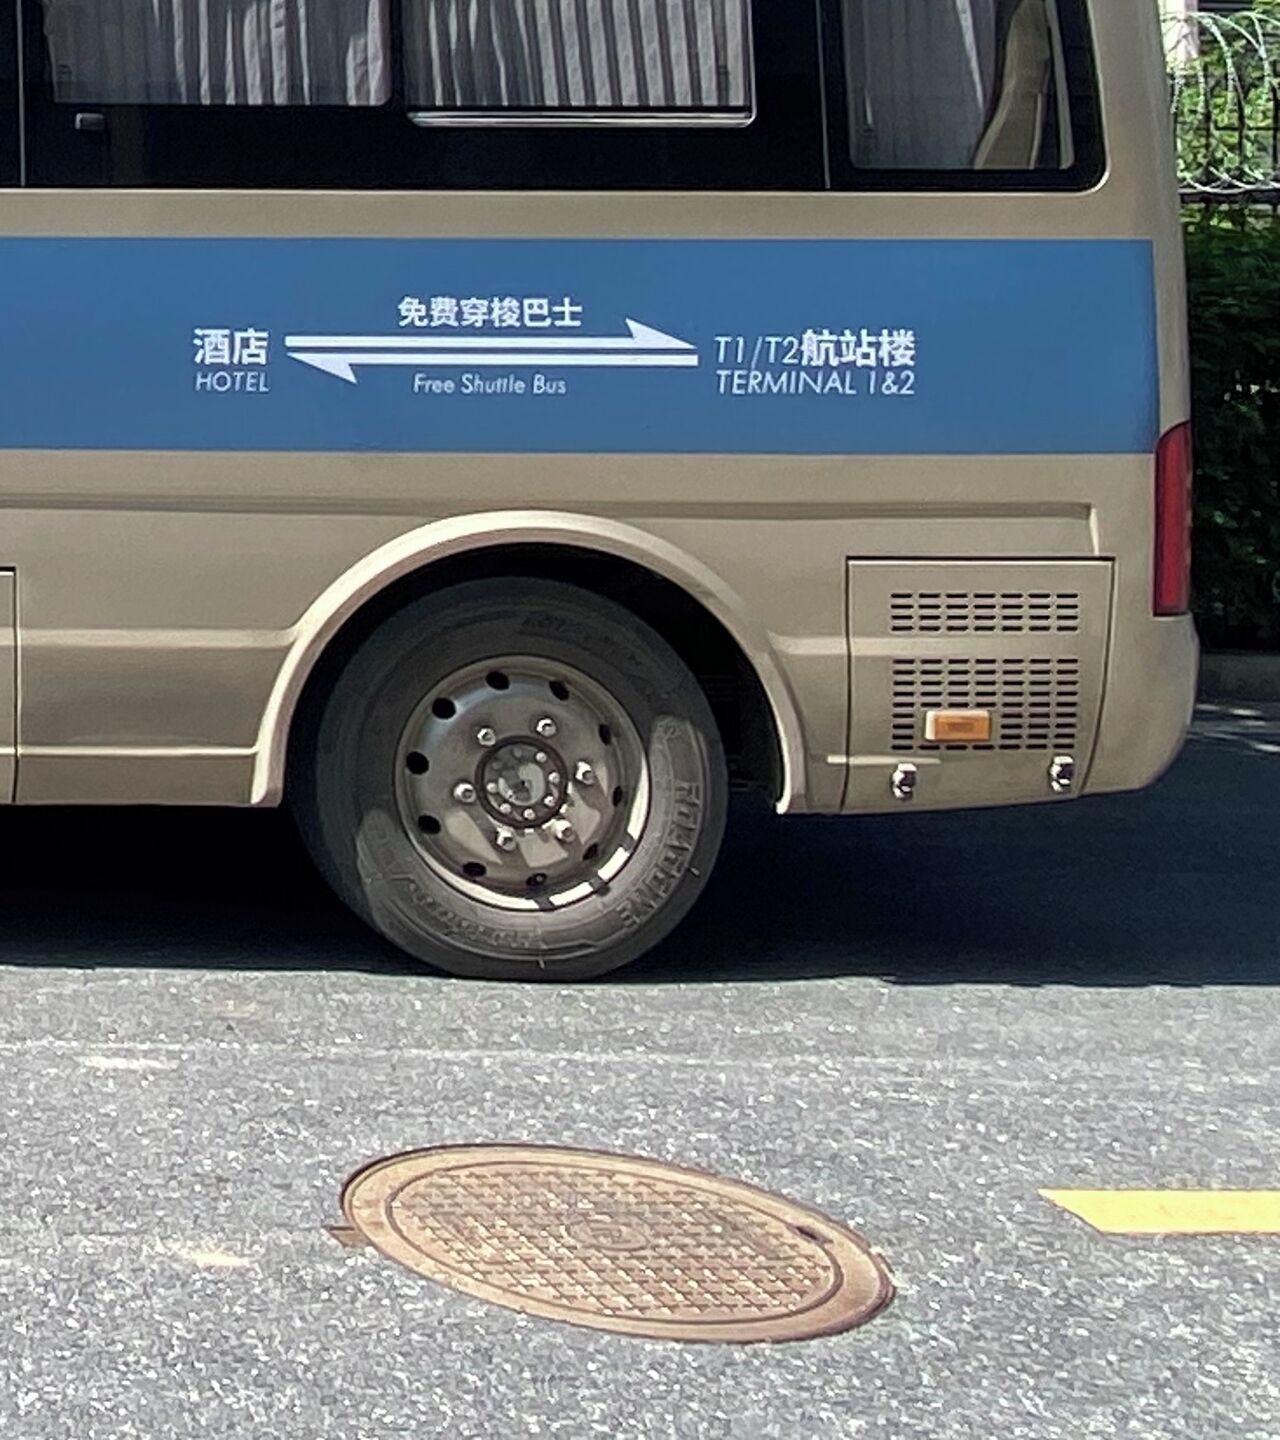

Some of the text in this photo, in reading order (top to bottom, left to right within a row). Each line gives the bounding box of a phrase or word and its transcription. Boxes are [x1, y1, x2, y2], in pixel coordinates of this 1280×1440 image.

[397, 296, 583, 328] 免费穿梭巴士
[193, 327, 269, 365] 酒店
[714, 328, 916, 368] T1/T2航站楼
[196, 371, 269, 392] HOTEL
[414, 373, 566, 394] Free Shuttle Bus
[716, 370, 915, 395] TERMINAL 1&2
